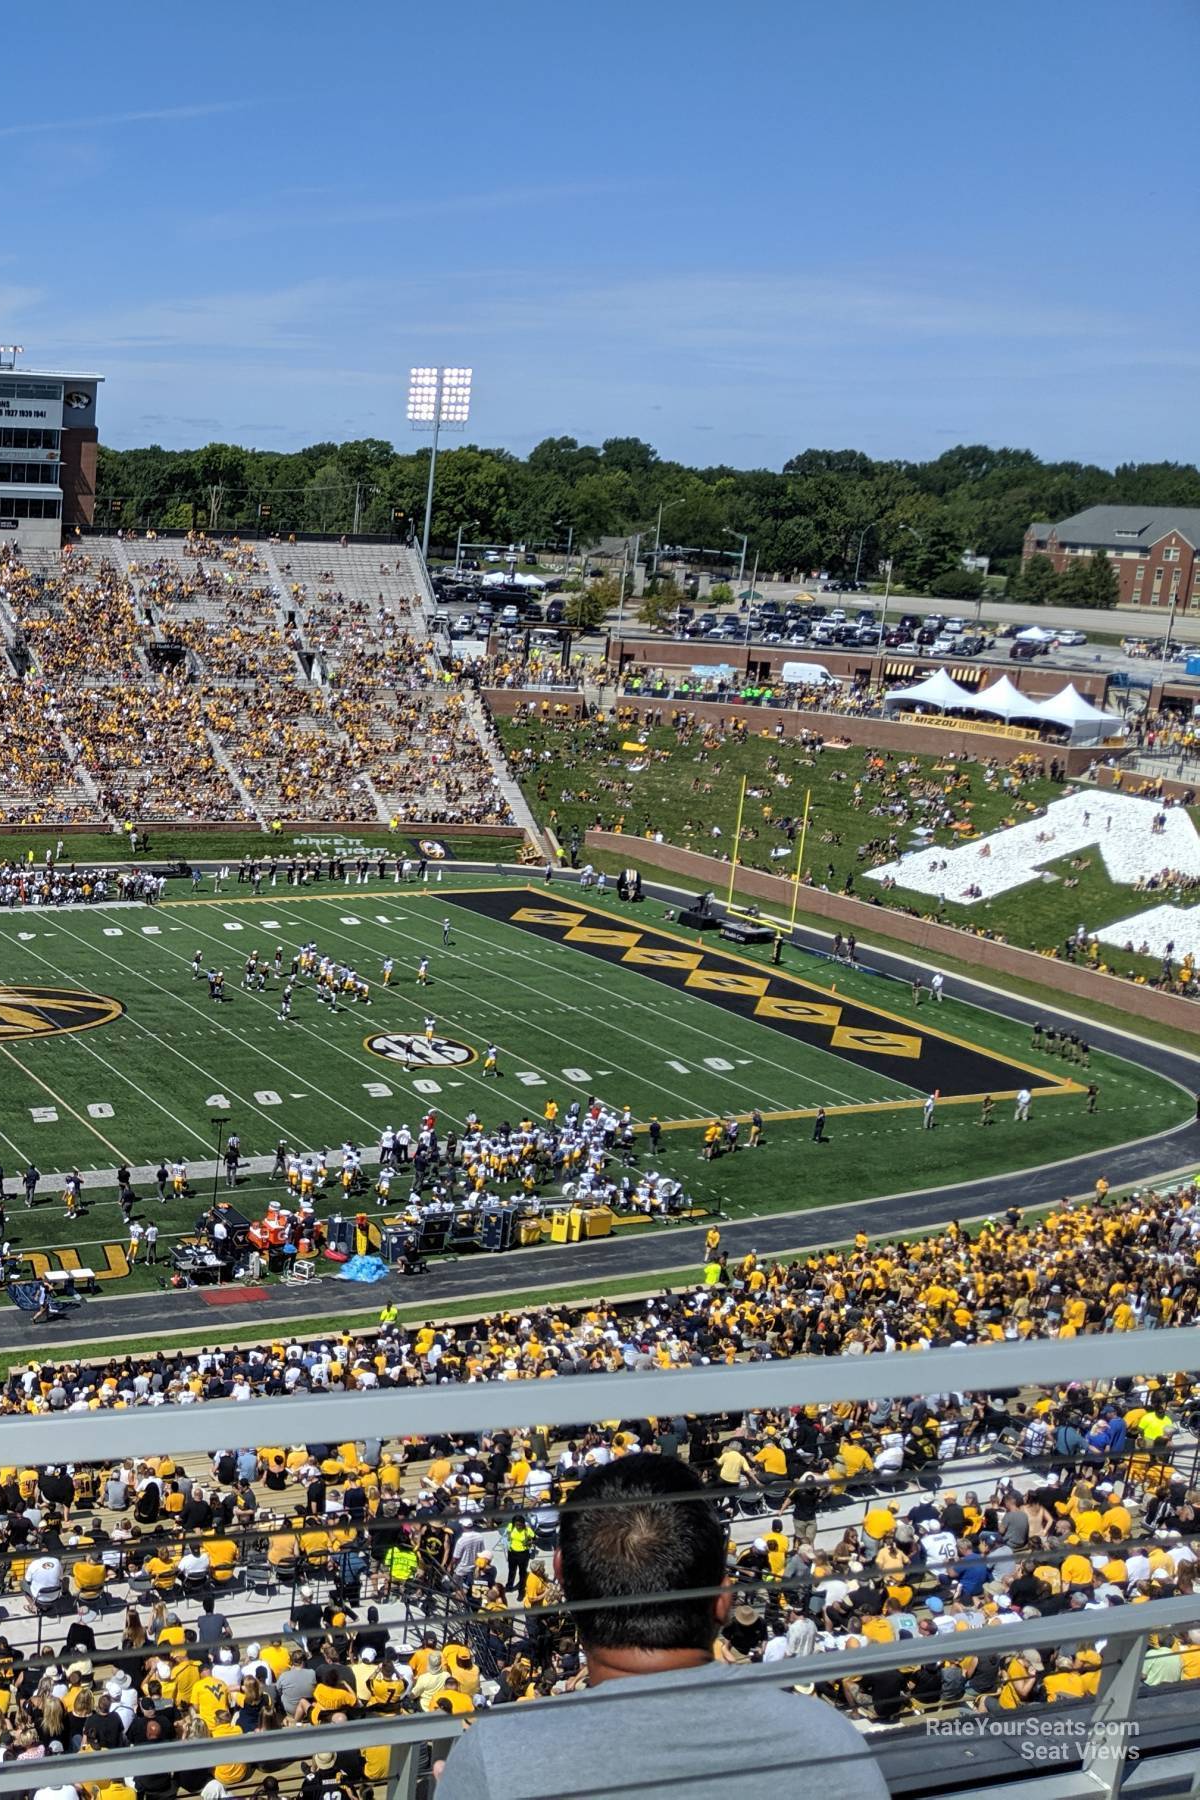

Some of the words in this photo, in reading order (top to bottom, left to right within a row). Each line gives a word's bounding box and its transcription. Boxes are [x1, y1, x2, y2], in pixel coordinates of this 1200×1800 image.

[915, 716, 957, 728] MIZZOU
[335, 847, 387, 855] RIGHT
[939, 1543, 955, 1559] 46
[387, 1688, 396, 1702] 7
